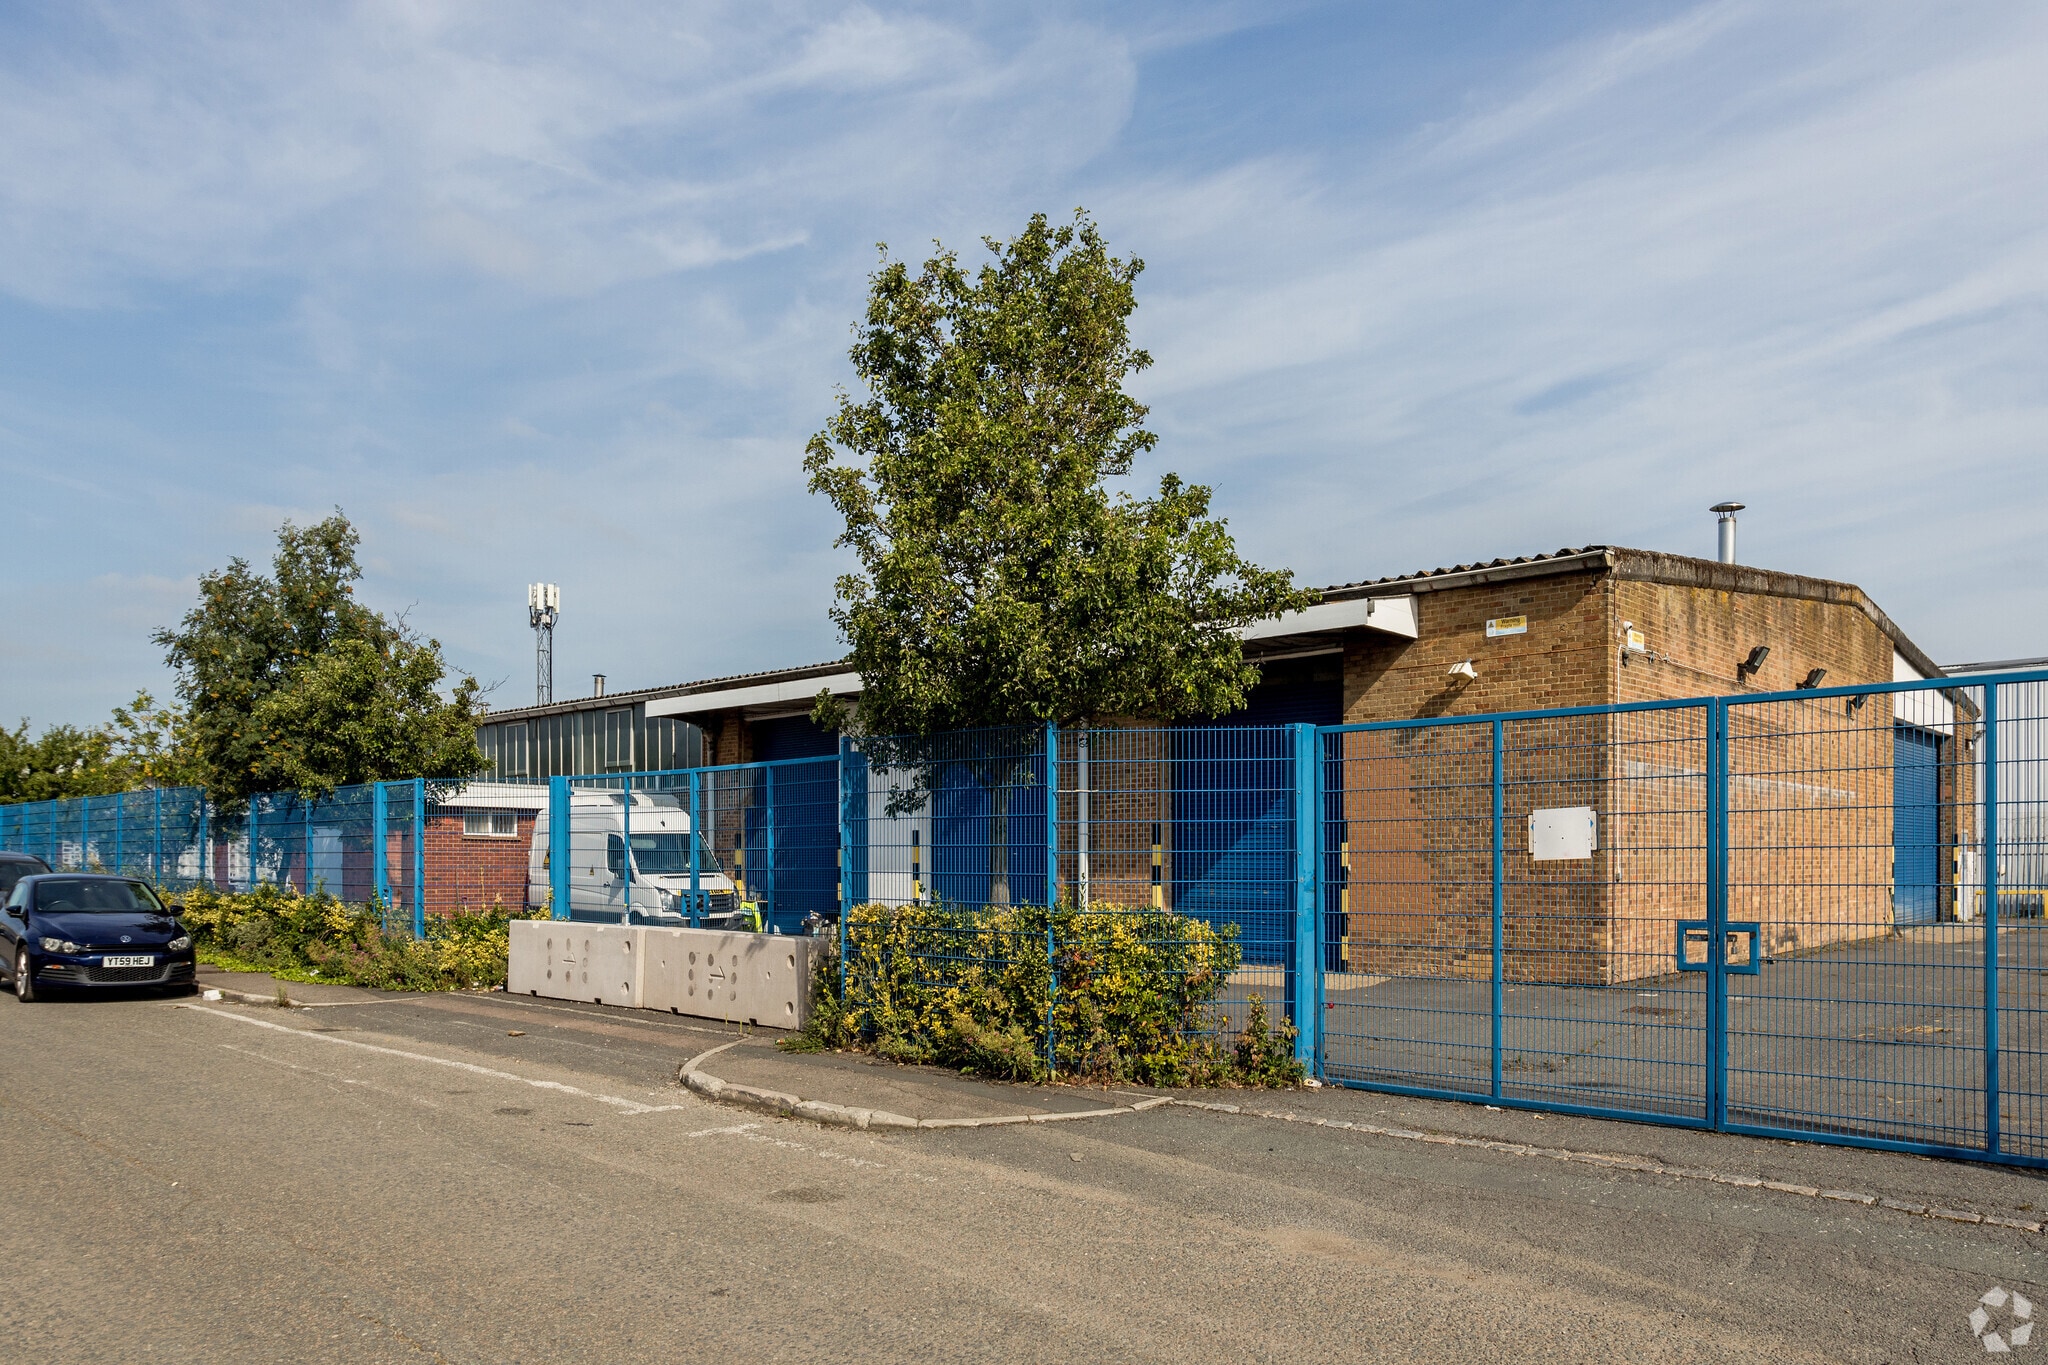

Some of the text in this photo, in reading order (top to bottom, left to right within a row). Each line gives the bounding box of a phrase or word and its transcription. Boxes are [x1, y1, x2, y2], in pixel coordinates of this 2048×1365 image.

[1501, 617, 1521, 625] Warning
[107, 957, 151, 966] YT59 HEJ
